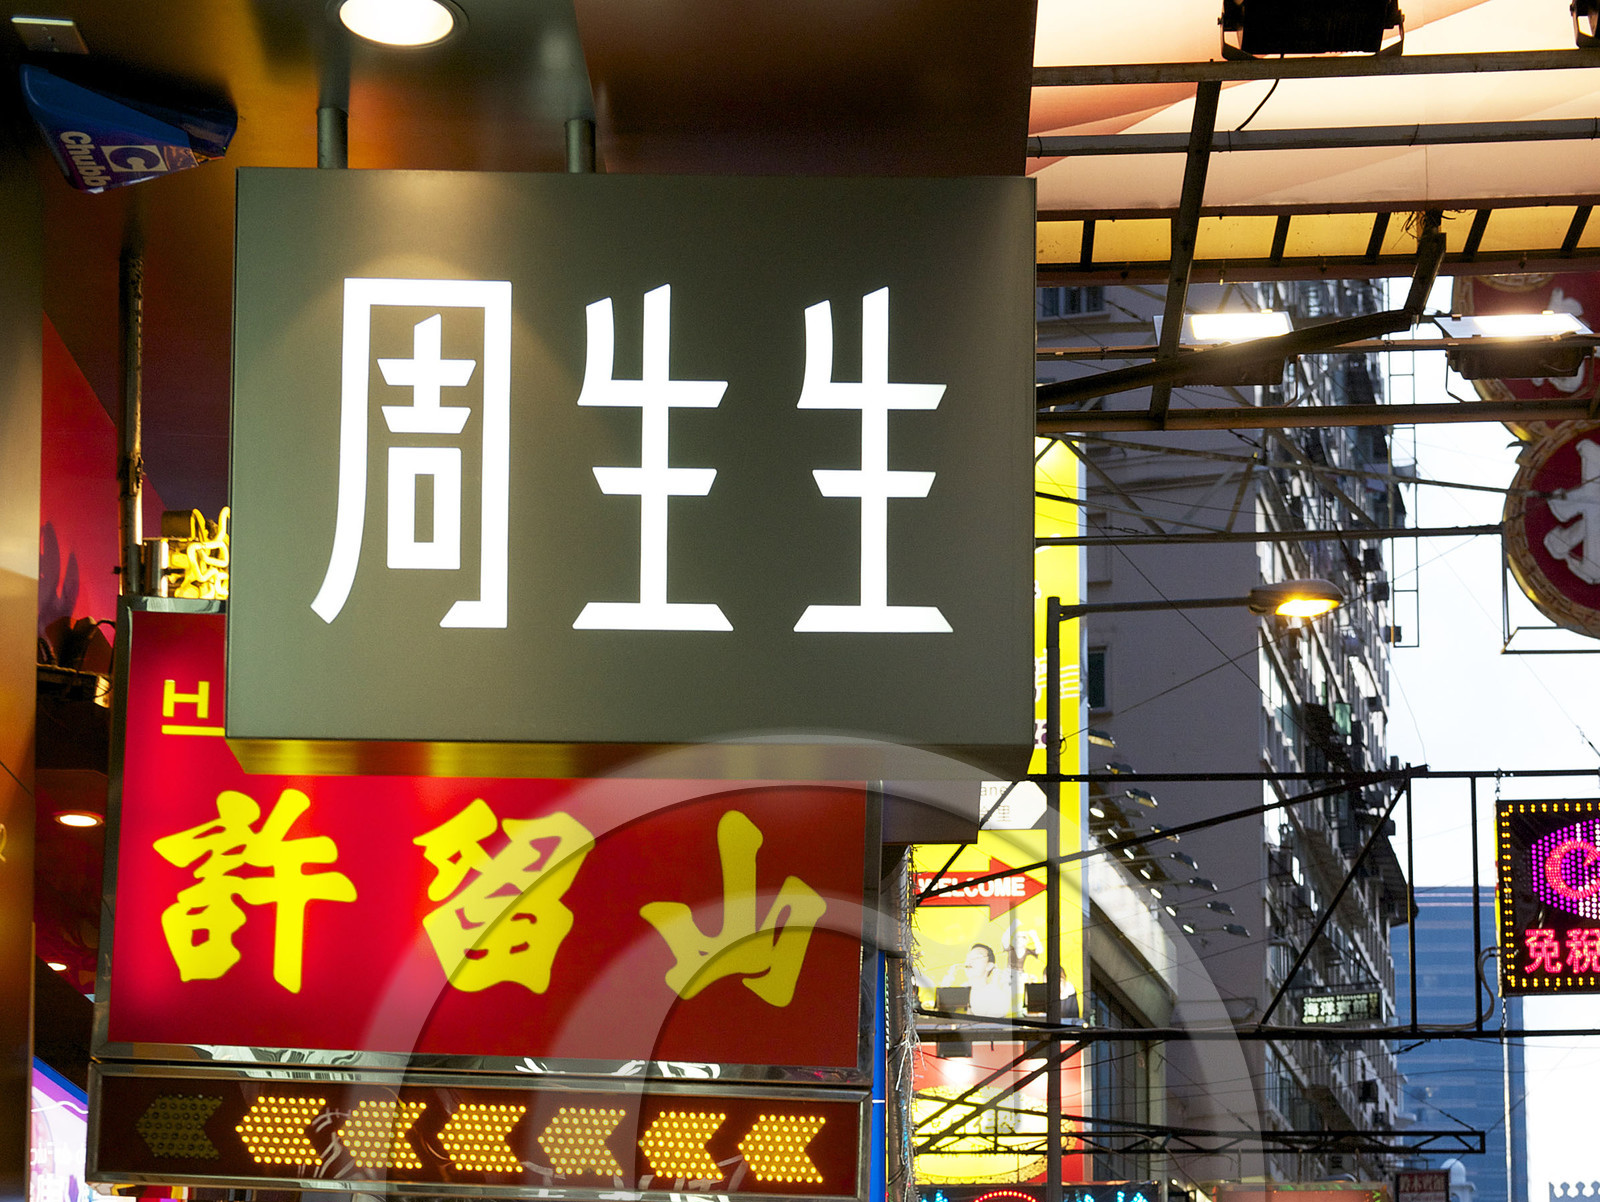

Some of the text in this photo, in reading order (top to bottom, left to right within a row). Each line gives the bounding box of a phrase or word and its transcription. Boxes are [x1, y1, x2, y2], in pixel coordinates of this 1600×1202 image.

[60, 131, 113, 187] Chubb
[310, 277, 953, 633] 周生生
[153, 788, 827, 1007] 許留山
